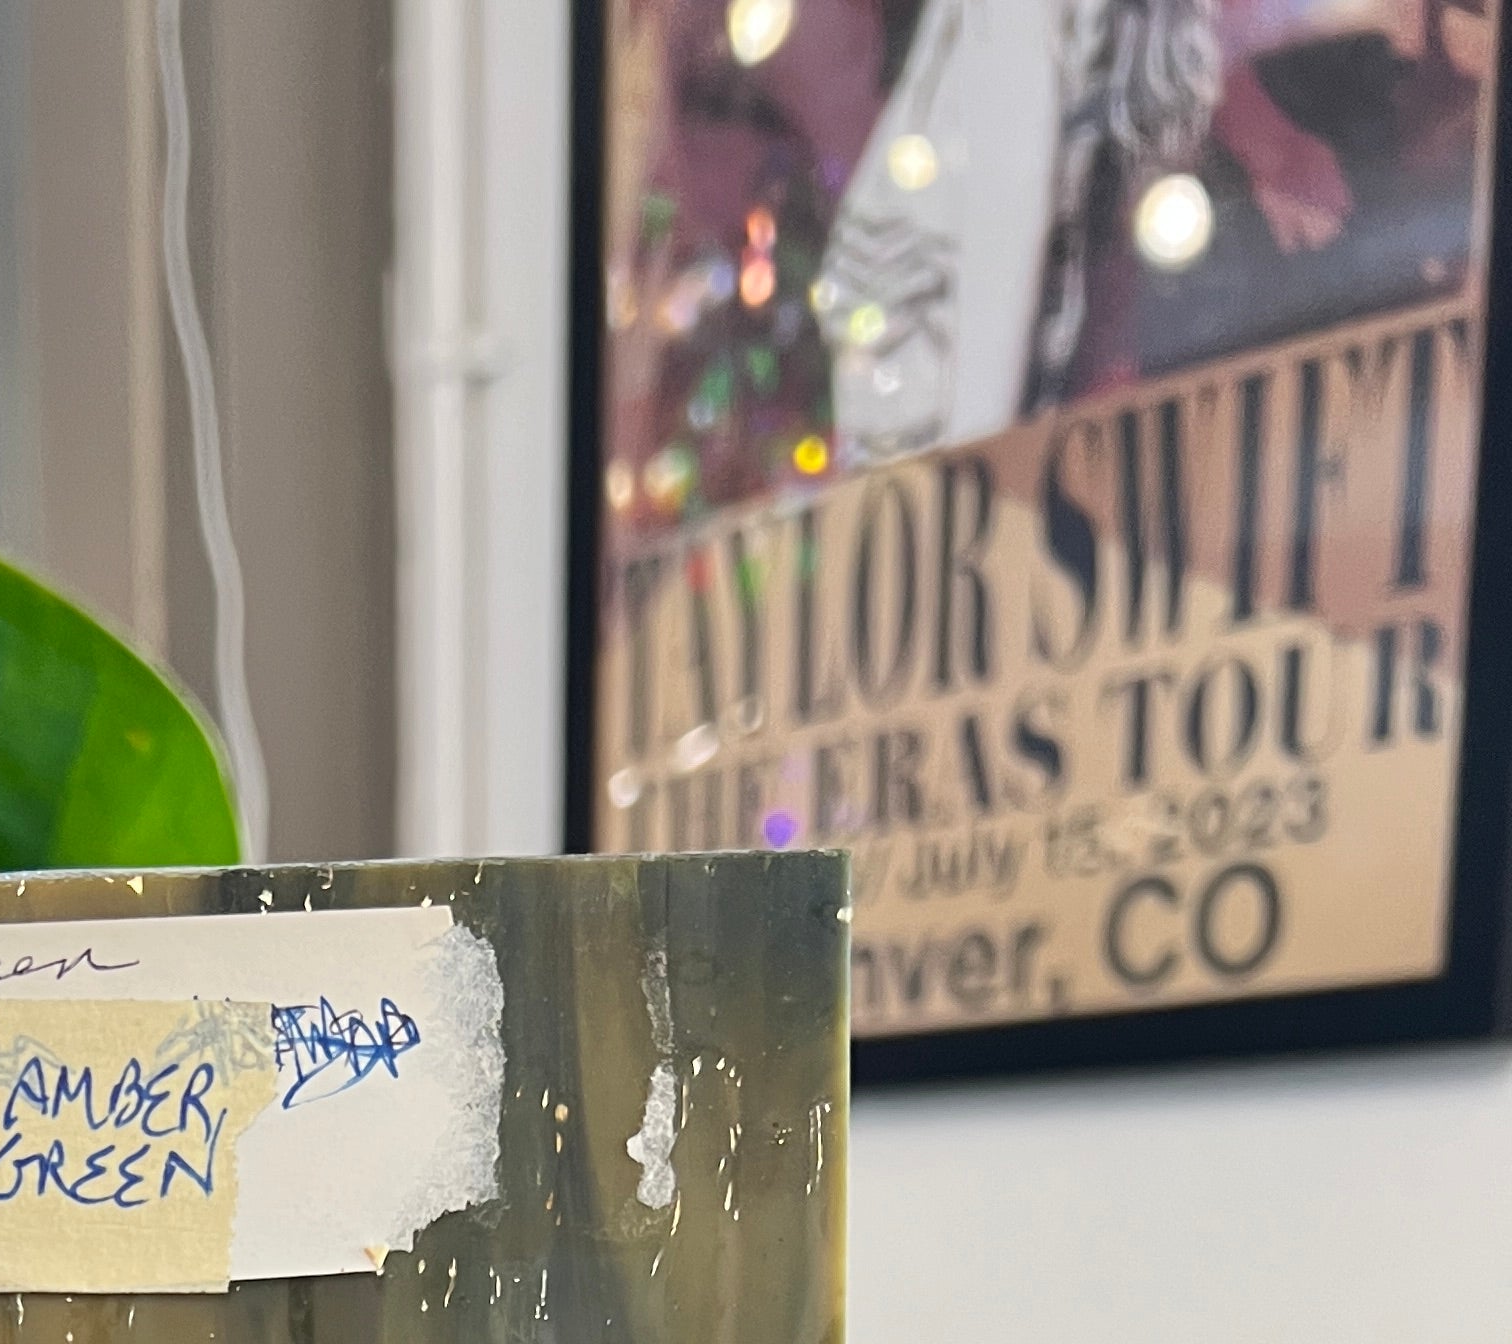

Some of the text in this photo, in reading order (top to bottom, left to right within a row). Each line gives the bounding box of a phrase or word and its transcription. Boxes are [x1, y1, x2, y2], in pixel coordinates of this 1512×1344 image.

[1100, 618, 1444, 788] TOUR
[1100, 860, 1283, 988] CO
[3, 1056, 216, 1144] AMBER
